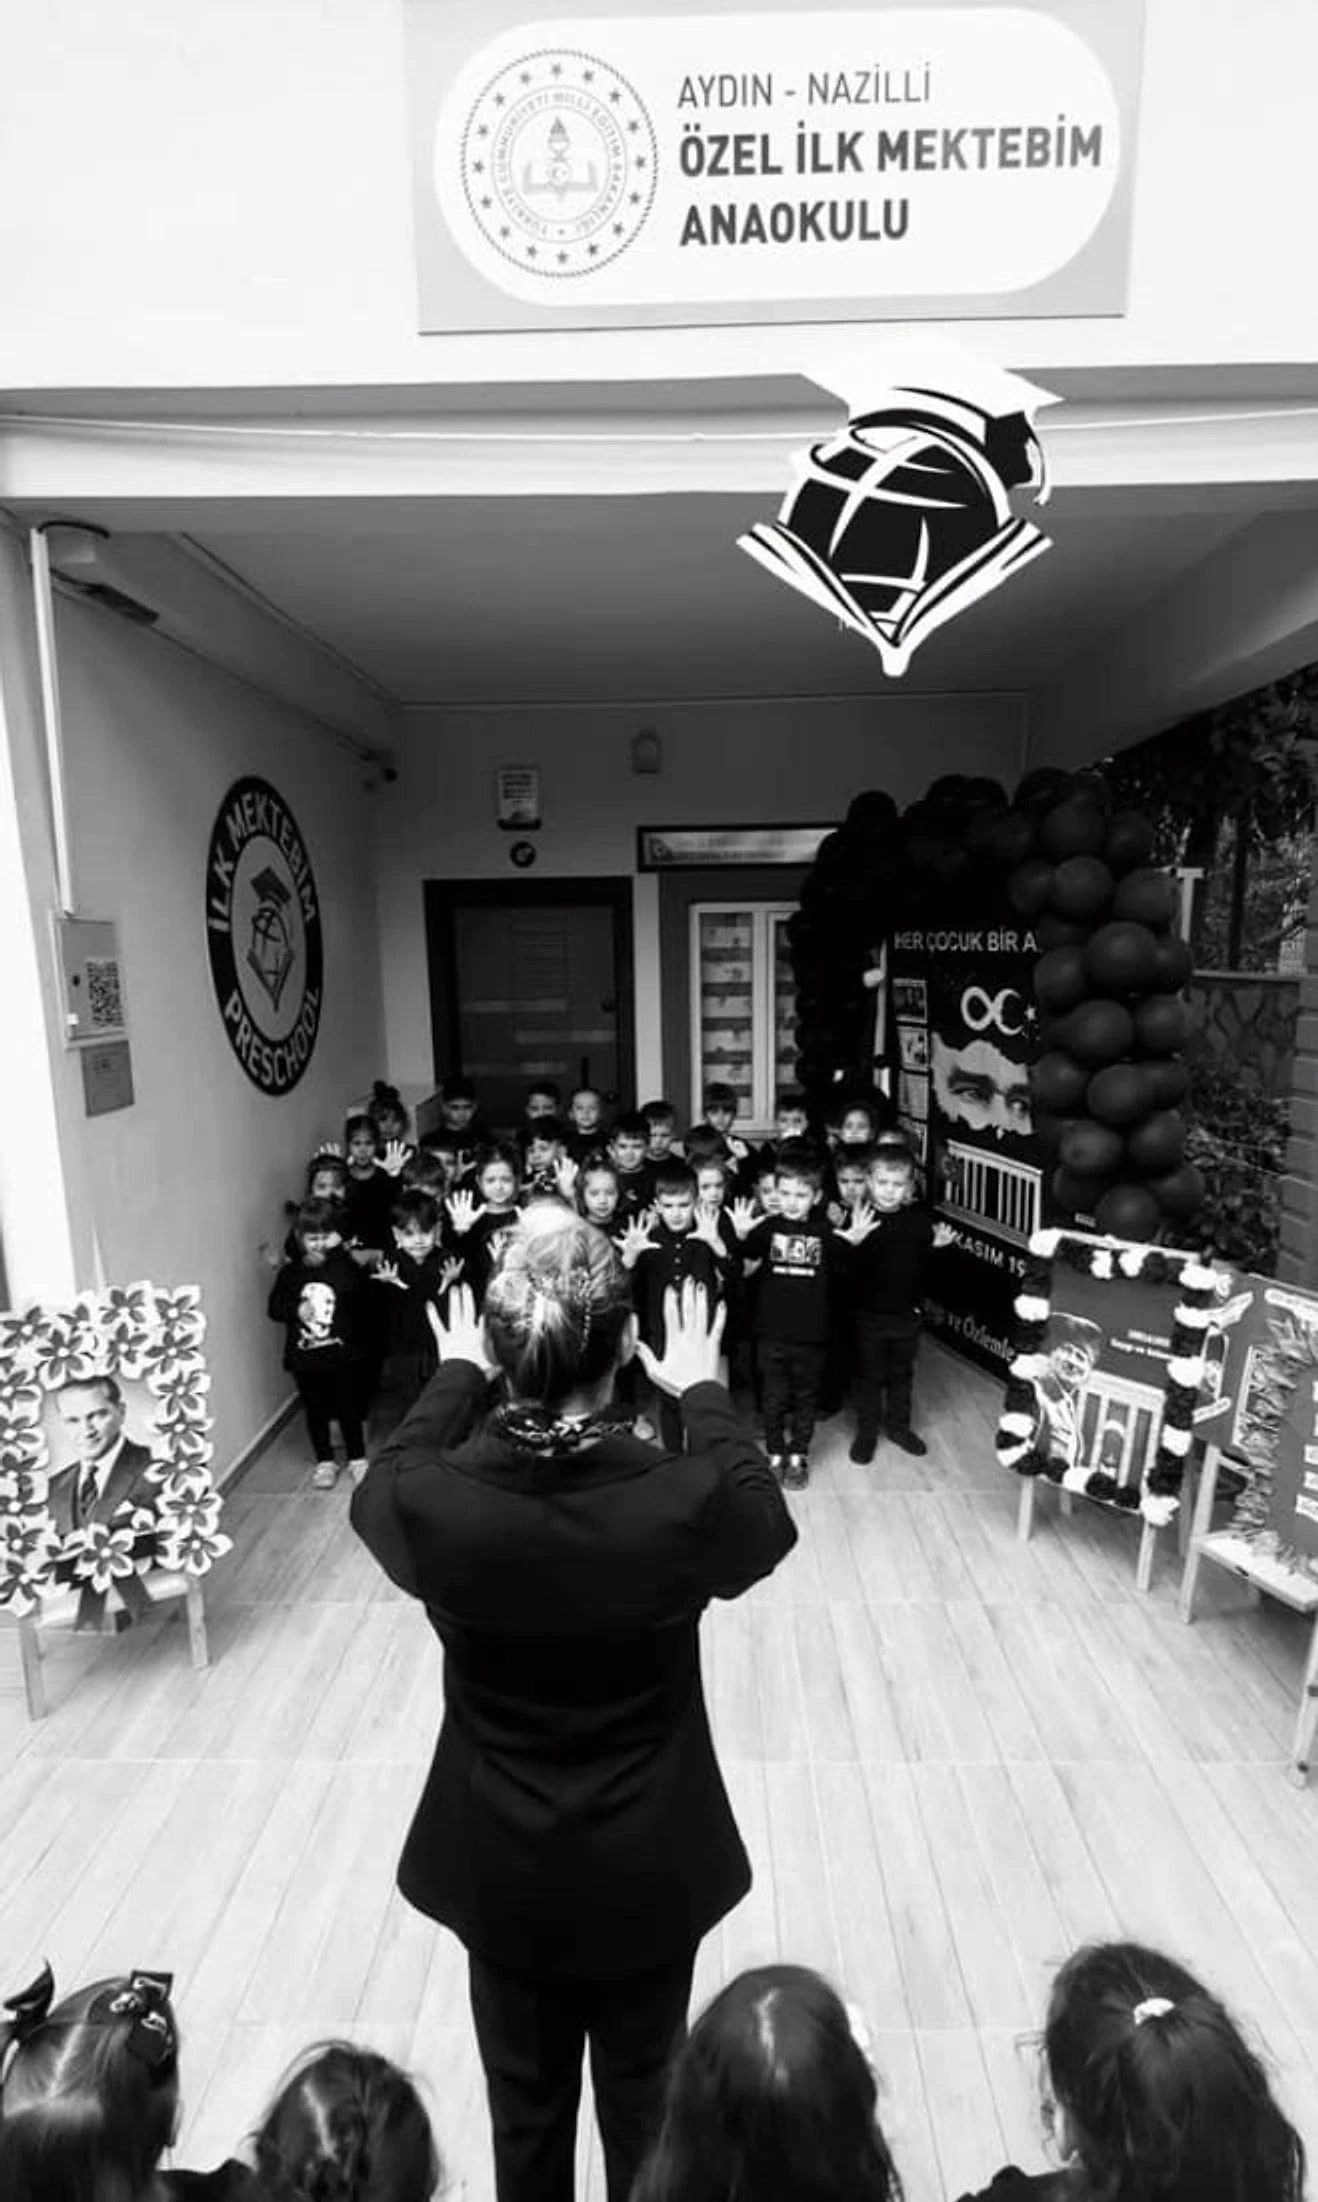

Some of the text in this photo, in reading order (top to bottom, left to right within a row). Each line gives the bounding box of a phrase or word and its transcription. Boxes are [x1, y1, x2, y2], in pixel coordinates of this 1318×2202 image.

[678, 62, 930, 108] AYDIN - NAZİLLİ
[680, 112, 1103, 178] ÖZEL İLK MEKTEBİM
[679, 198, 909, 247] ANAOKULU
[893, 927, 1040, 955] HER ÇOCUK BİR A
[224, 987, 319, 1086] PRESCHOOL
[1008, 1255, 1027, 1279] 19
